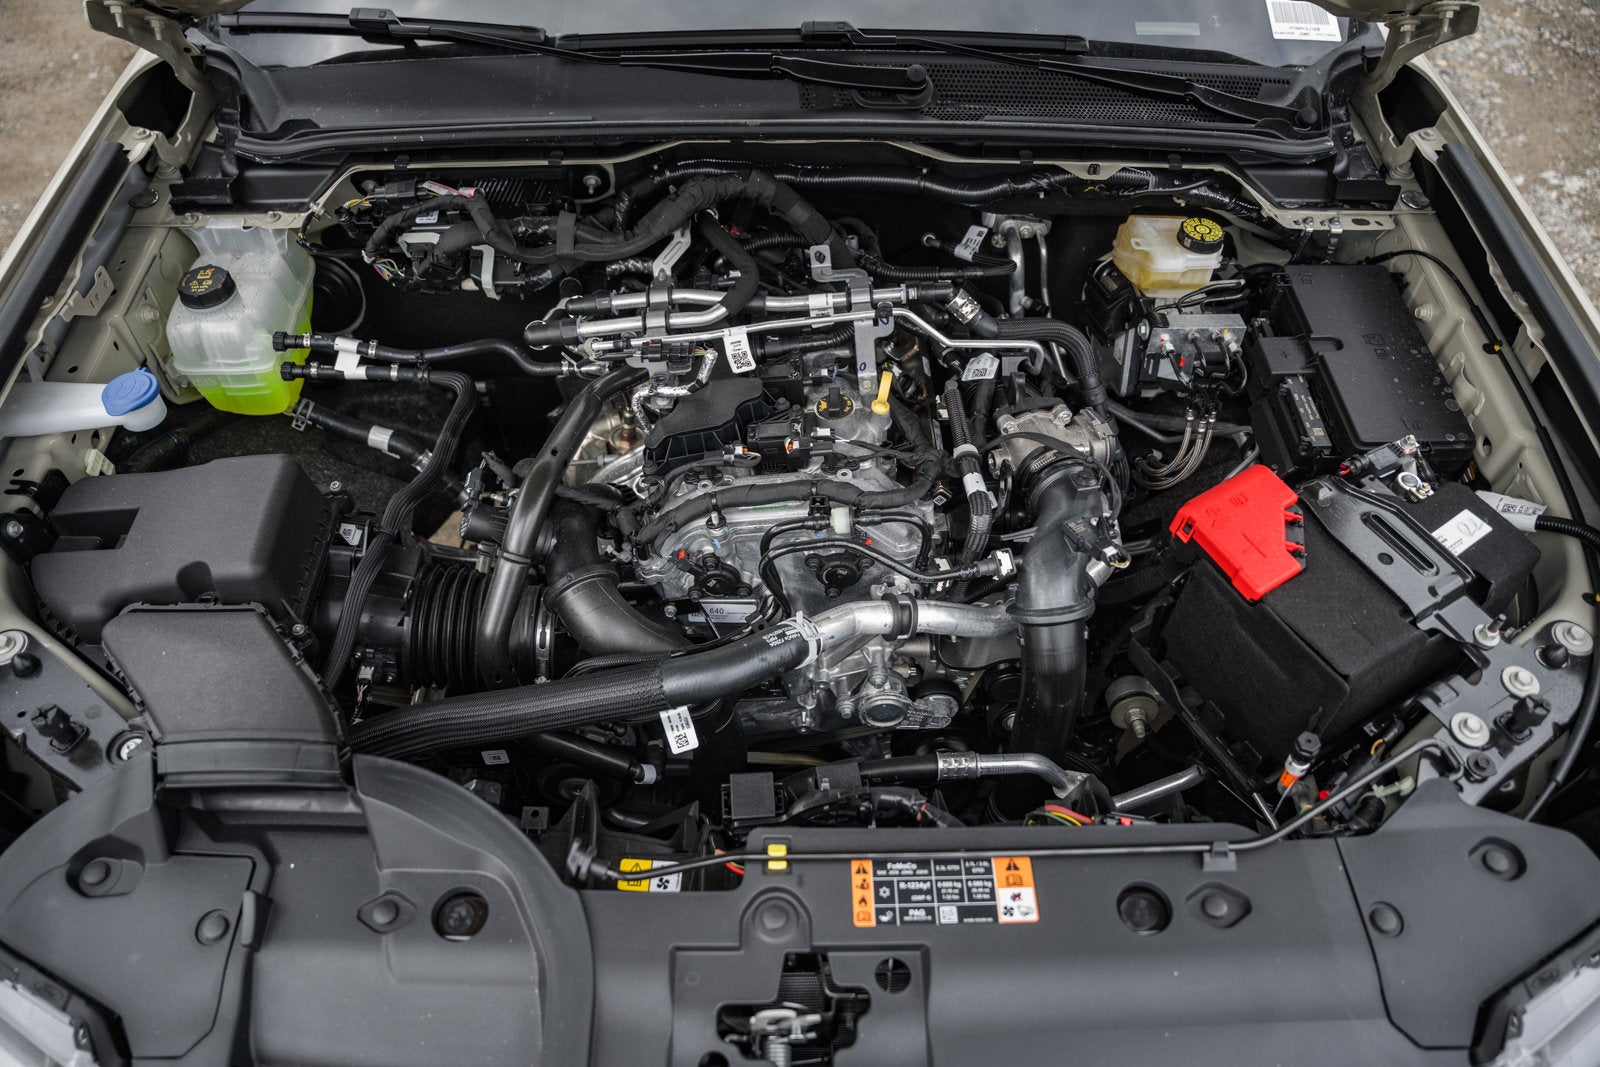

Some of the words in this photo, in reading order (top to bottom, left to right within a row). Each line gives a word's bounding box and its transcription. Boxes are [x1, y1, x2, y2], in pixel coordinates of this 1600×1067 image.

[887, 862, 917, 870] FoMoCo
[899, 881, 930, 891] R-1234yf
[908, 908, 926, 916] PAG
